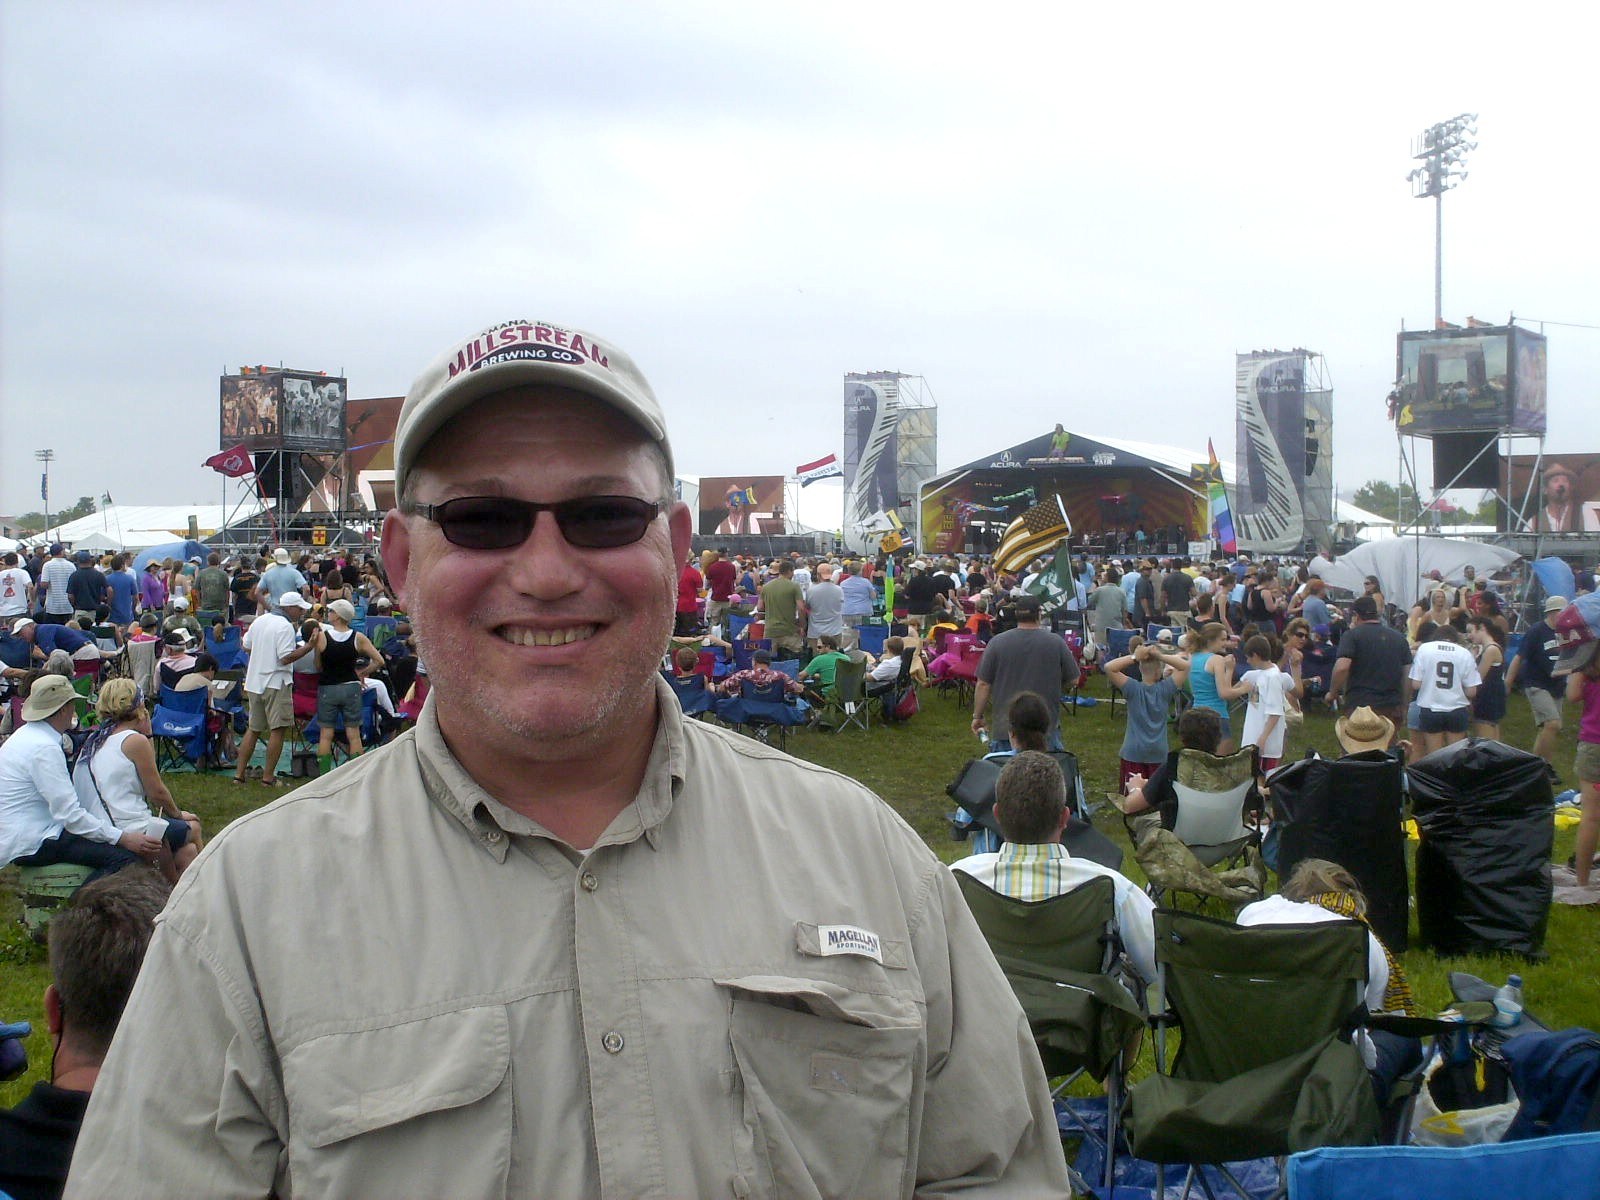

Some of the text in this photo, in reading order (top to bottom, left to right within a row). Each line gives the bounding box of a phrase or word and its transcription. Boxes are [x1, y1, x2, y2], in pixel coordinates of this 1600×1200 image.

[447, 325, 609, 380] MILLSTREAM
[481, 349, 577, 368] BREWING CO.
[1436, 661, 1454, 690] 9
[828, 930, 879, 950] MAGELLAN
